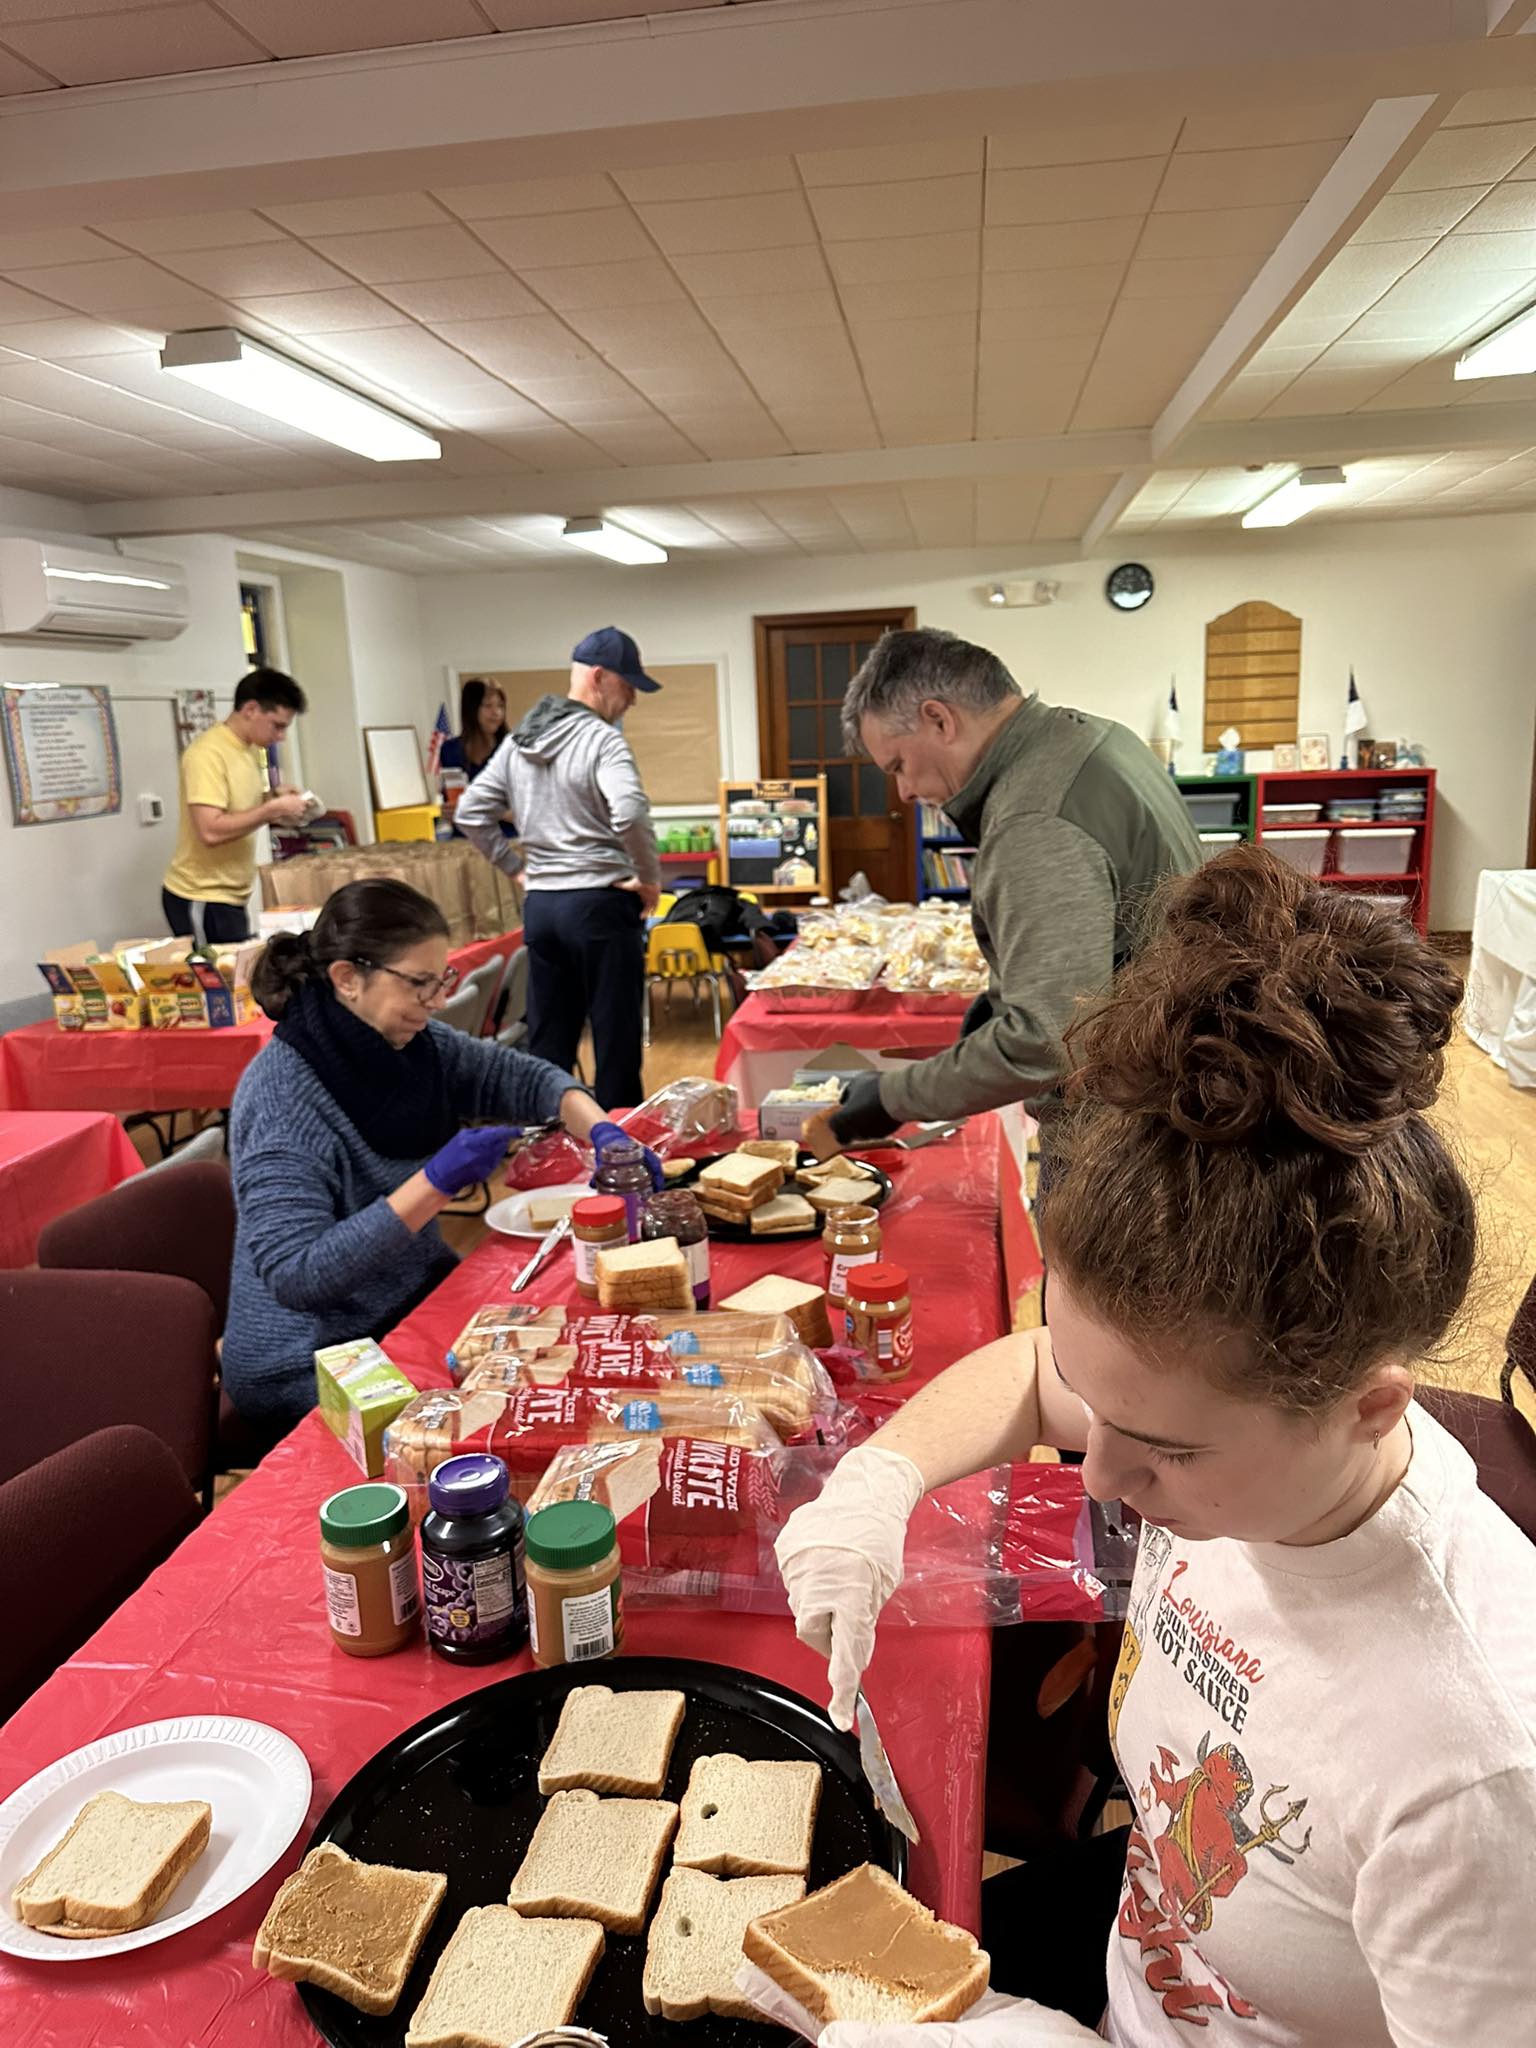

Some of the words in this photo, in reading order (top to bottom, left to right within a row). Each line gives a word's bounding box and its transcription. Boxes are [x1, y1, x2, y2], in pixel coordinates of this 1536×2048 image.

[672, 1471, 687, 1507] bread
[1153, 1611, 1184, 1667] HOT
[1184, 1658, 1247, 1735] SAUCE
[1159, 1595, 1188, 1643] CAJUN
[1189, 1635, 1249, 1705] INSPIRED
[1163, 1561, 1264, 1684] Louisiana
